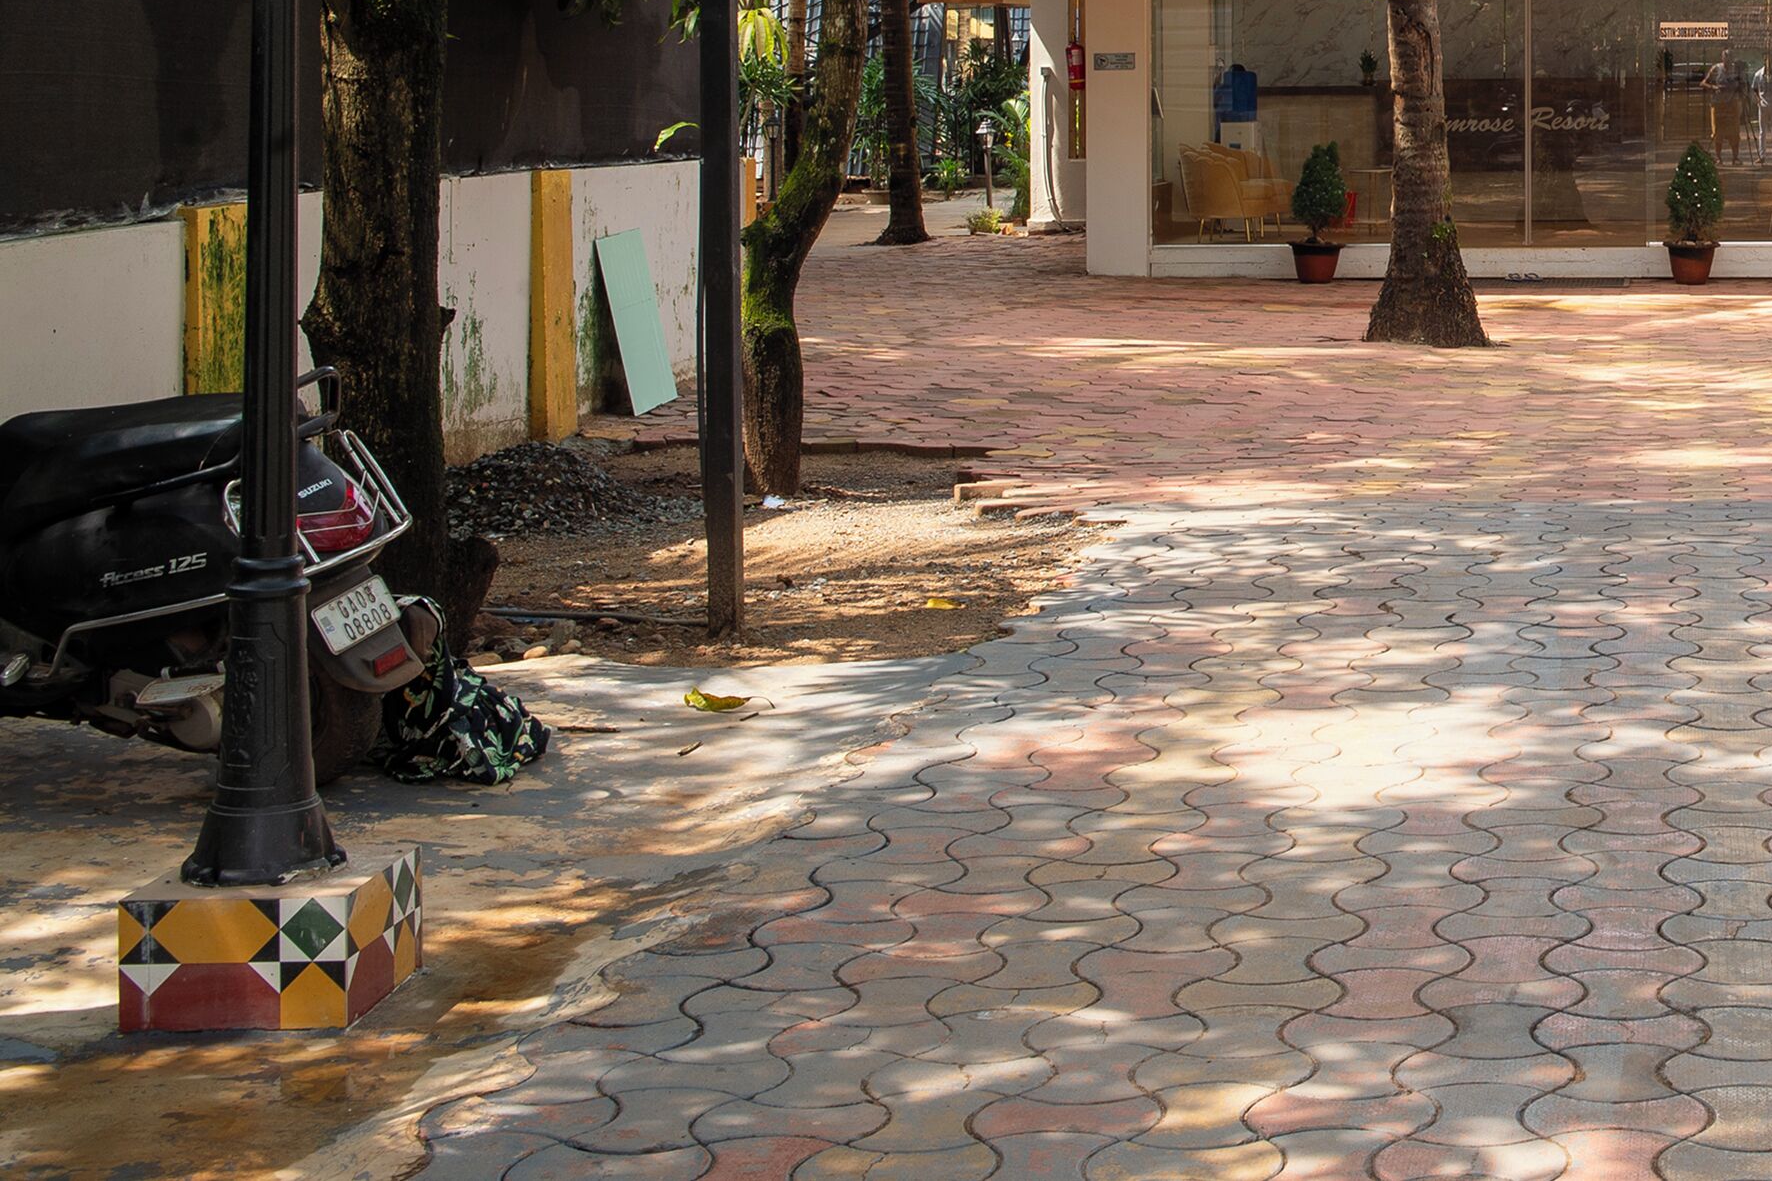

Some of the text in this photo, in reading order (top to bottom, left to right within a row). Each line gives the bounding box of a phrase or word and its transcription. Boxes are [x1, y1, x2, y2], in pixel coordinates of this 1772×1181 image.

[1531, 106, 1610, 132] Resort
[297, 479, 333, 499] SUZUKI
[99, 552, 208, 588] Access 125
[336, 586, 376, 619] GA08
